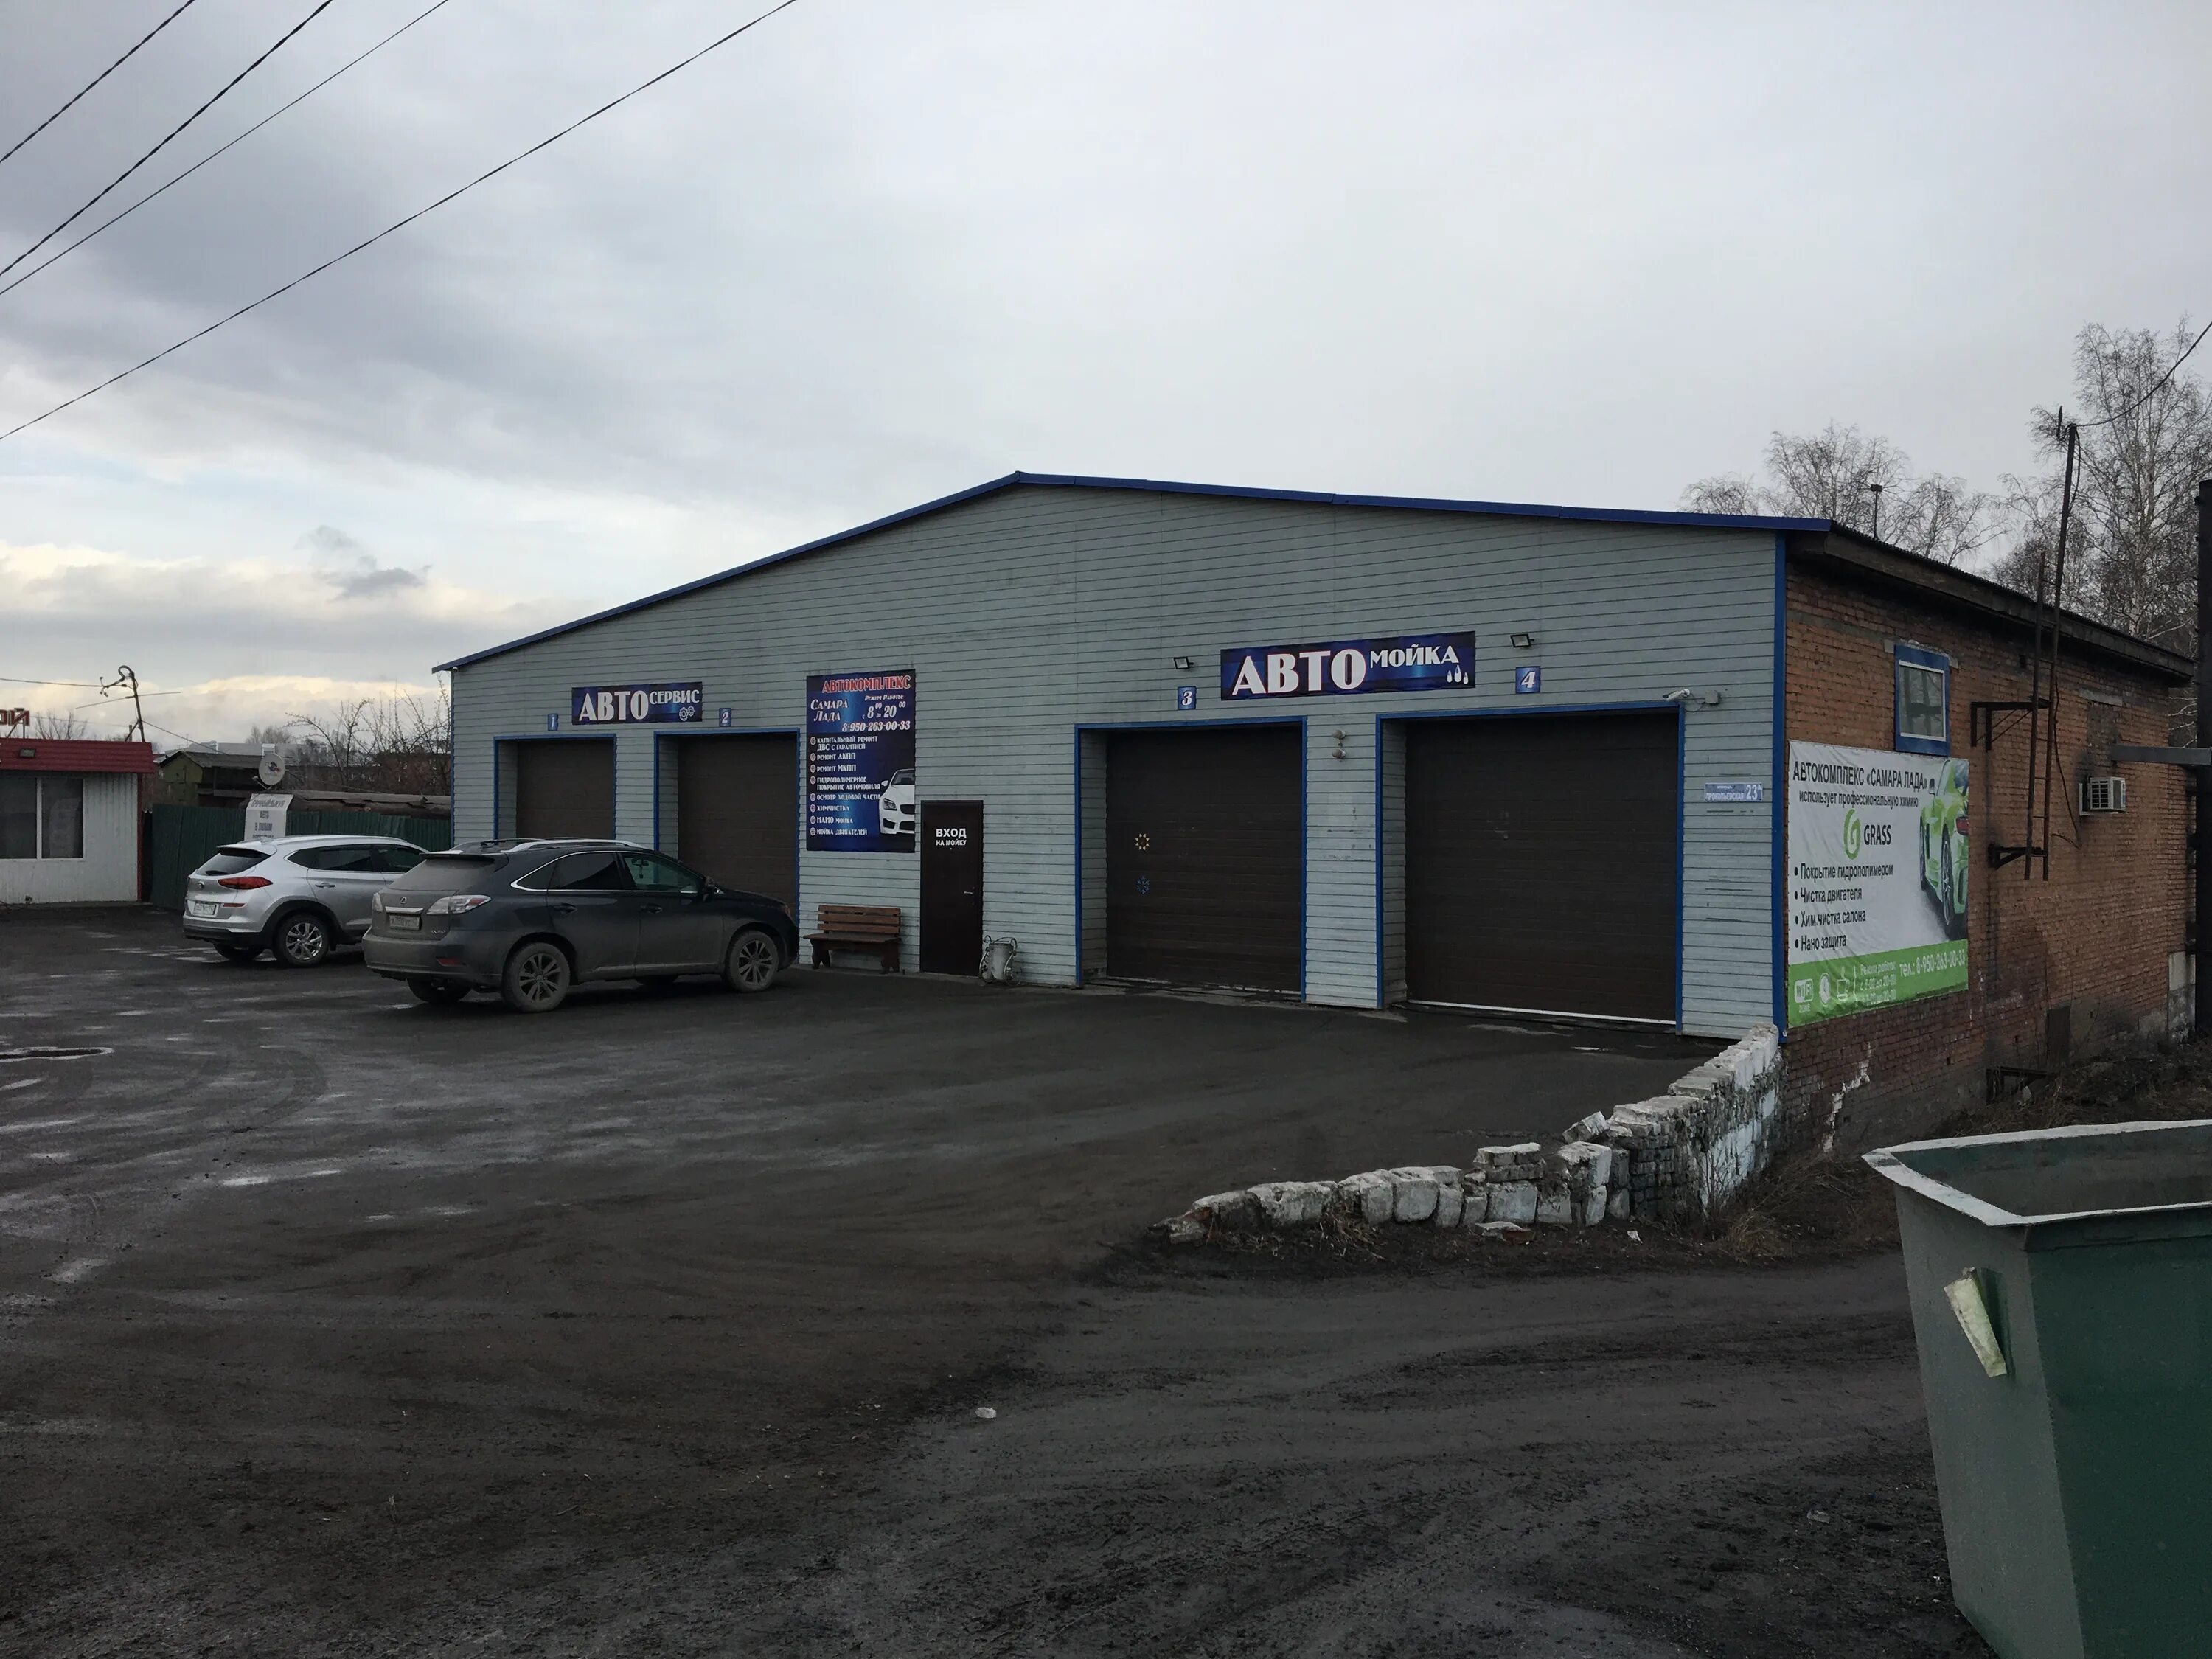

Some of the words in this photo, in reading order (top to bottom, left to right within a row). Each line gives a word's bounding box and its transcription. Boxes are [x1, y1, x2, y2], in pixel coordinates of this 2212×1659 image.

[1231, 648, 1367, 695] АВТО
[1370, 644, 1460, 669] МОЙКА
[822, 675, 911, 693] АВТОКОМПЛЕКС
[1520, 671, 1537, 689] 4
[579, 689, 649, 722] АВТО
[649, 689, 700, 704] СЕРВИС
[810, 699, 849, 710] САМАРА
[1181, 691, 1192, 706] 3
[721, 712, 728, 723] 2
[813, 711, 841, 722] ЛАДА
[867, 706, 874, 719] 8
[883, 705, 897, 718] 20
[898, 700, 906, 709] 00
[841, 720, 911, 732] 8-950-263-00-33
[817, 743, 830, 751] ДВС
[1792, 761, 1864, 786] АВТОКОМПЛЕКС
[1866, 768, 1902, 788] «САМАРА
[1903, 771, 1928, 793] ЛАДА»
[1799, 790, 1837, 808] использует
[1838, 790, 1899, 810] профессиональную
[1899, 796, 1919, 807] химию
[936, 828, 967, 839] ВХОД
[1863, 824, 1891, 845] GRASS
[1801, 863, 1836, 883] Покрытие
[1837, 864, 1893, 882] гидрополимером
[1801, 887, 1826, 903] Чистка
[1827, 888, 1863, 904] двигателя
[1843, 910, 1866, 924] салона
[1801, 935, 1820, 951] Нано
[1821, 934, 1847, 950] защита
